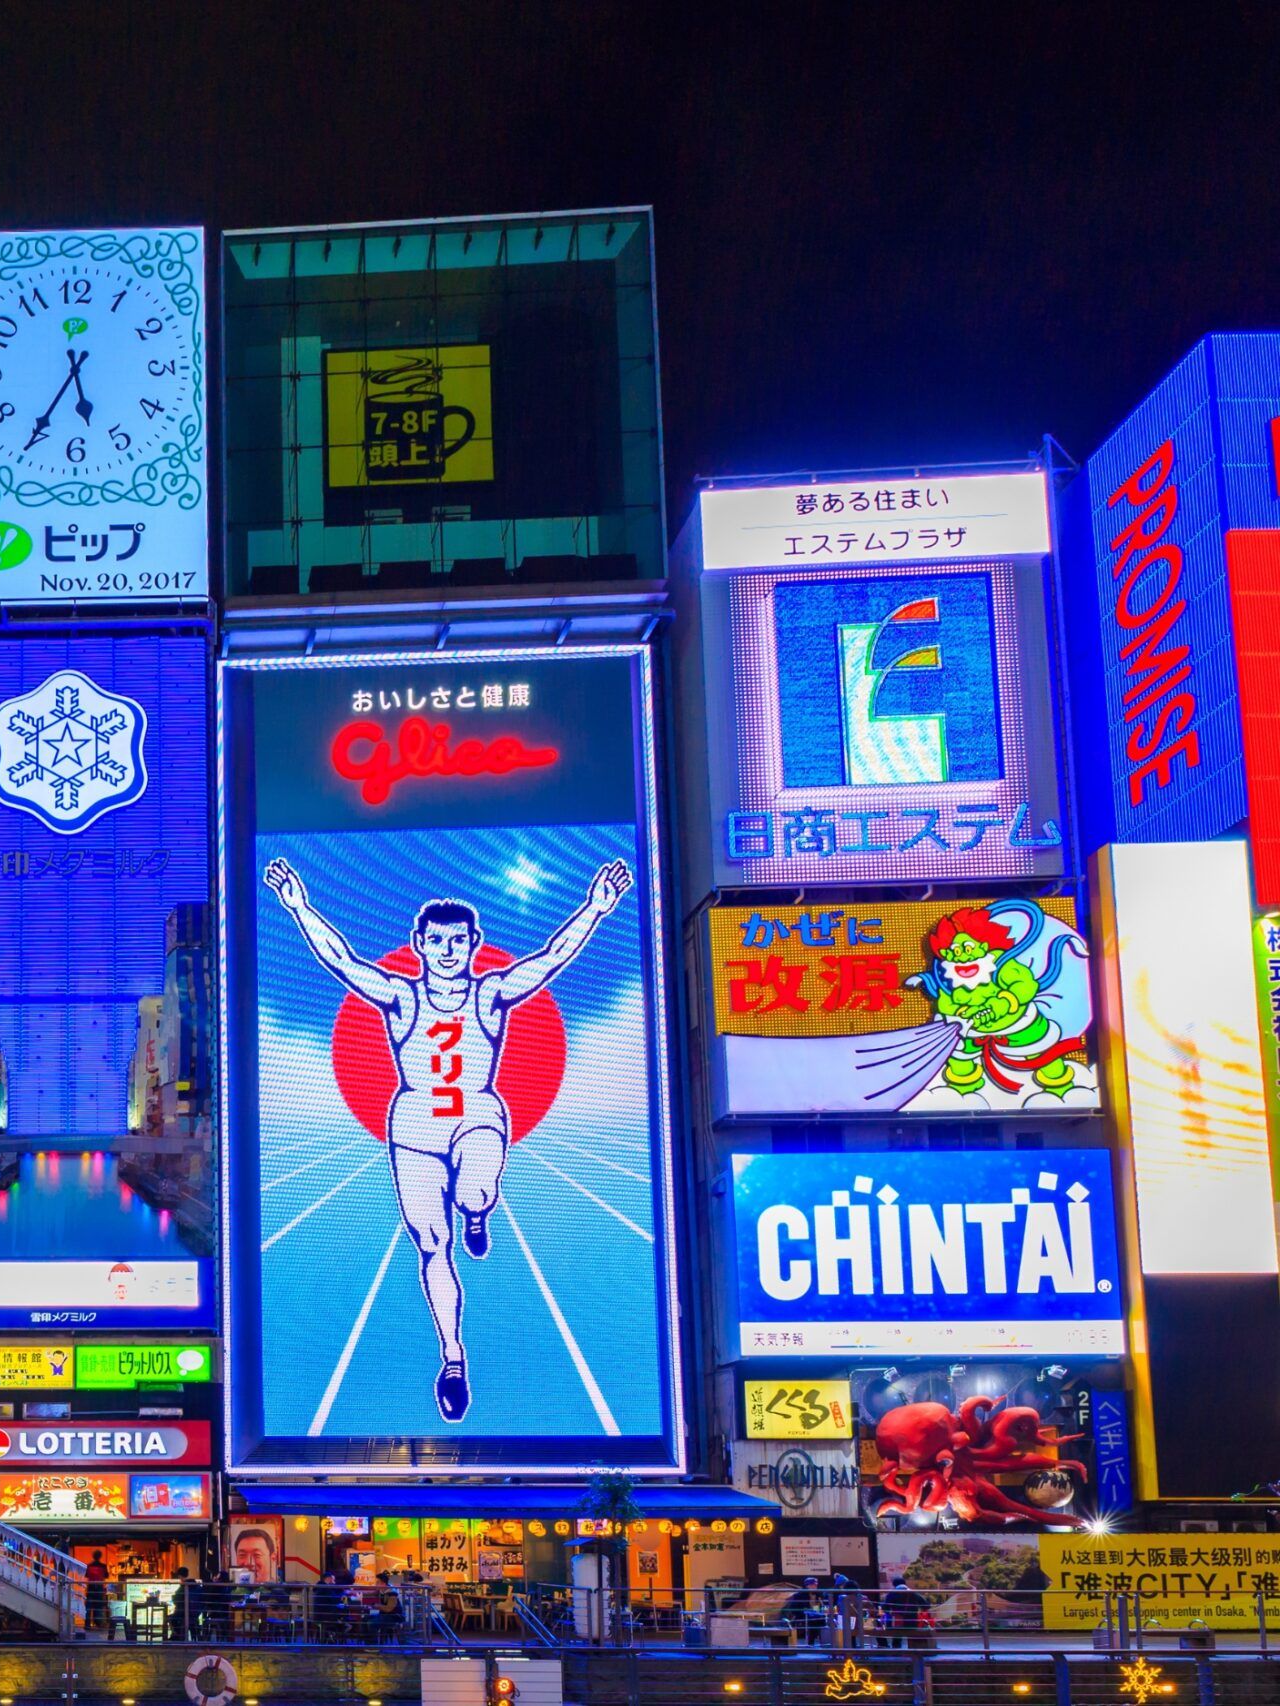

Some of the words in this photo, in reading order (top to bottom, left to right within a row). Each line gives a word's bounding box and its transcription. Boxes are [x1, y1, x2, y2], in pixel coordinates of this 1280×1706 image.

[18, 287, 50, 317] 11
[59, 279, 93, 304] 12
[110, 290, 128, 313] 1
[134, 317, 163, 341] 2
[148, 359, 176, 377] 3
[139, 397, 166, 420] 4
[370, 410, 439, 435] 7-8F
[66, 436, 87, 463] 6
[108, 423, 132, 451] 5
[796, 488, 950, 516] 夢ある住まい
[44, 522, 146, 562] ピップ
[784, 527, 967, 556] エステムプラザ
[40, 574, 91, 592] Nov.
[97, 573, 133, 591] 20,
[140, 571, 196, 589] 2017
[1108, 439, 1202, 808] PROMISE
[351, 684, 531, 712] おいしさと健康
[332, 717, 559, 805] Glico
[728, 801, 1062, 859] 日商エステム
[740, 910, 884, 949] かぜに
[726, 953, 905, 1014] 改源
[426, 1016, 465, 1118] グリコ
[757, 1171, 1096, 1301] CHINTAI
[30, 1311, 97, 1323] 雪印メグミルク
[754, 1332, 804, 1347] 天気予報
[119, 1351, 172, 1375] ピタットハウス
[765, 1388, 830, 1430] くくる
[19, 1431, 167, 1455] LOTTERIA
[38, 1476, 89, 1489] たこやき
[830, 1463, 859, 1489] BAR
[426, 1533, 467, 1551] 串カツ
[428, 1556, 469, 1572] お好み
[1063, 1606, 1099, 1619] Largest
[1173, 1607, 1201, 1616] center
[1205, 1605, 1213, 1616] in
